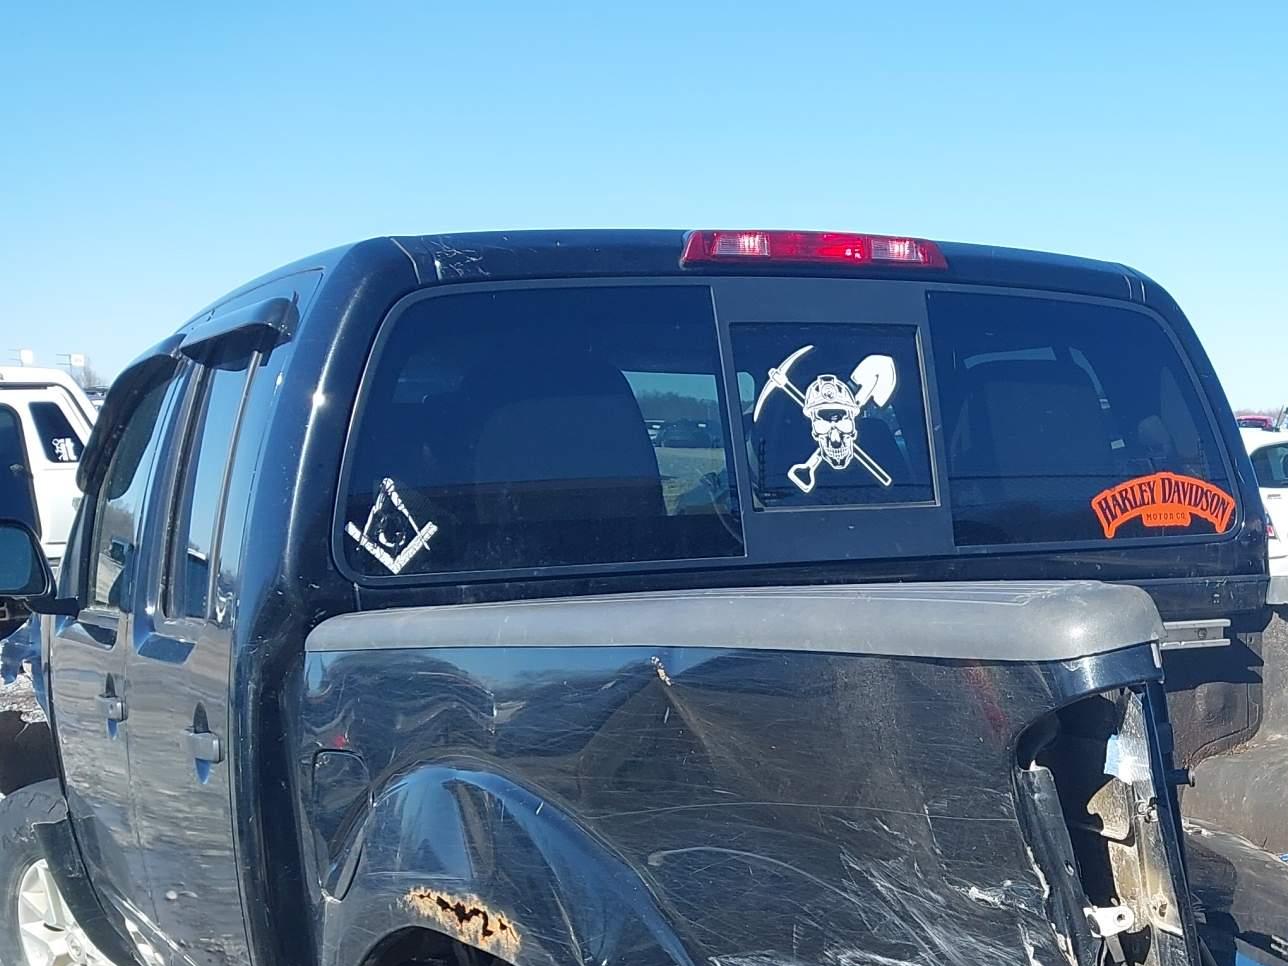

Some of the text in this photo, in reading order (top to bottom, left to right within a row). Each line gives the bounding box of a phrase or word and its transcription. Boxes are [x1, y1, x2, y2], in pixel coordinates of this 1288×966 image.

[1097, 477, 1230, 524] HARLEY DAVIDSON
[1146, 512, 1174, 521] MOTOR
